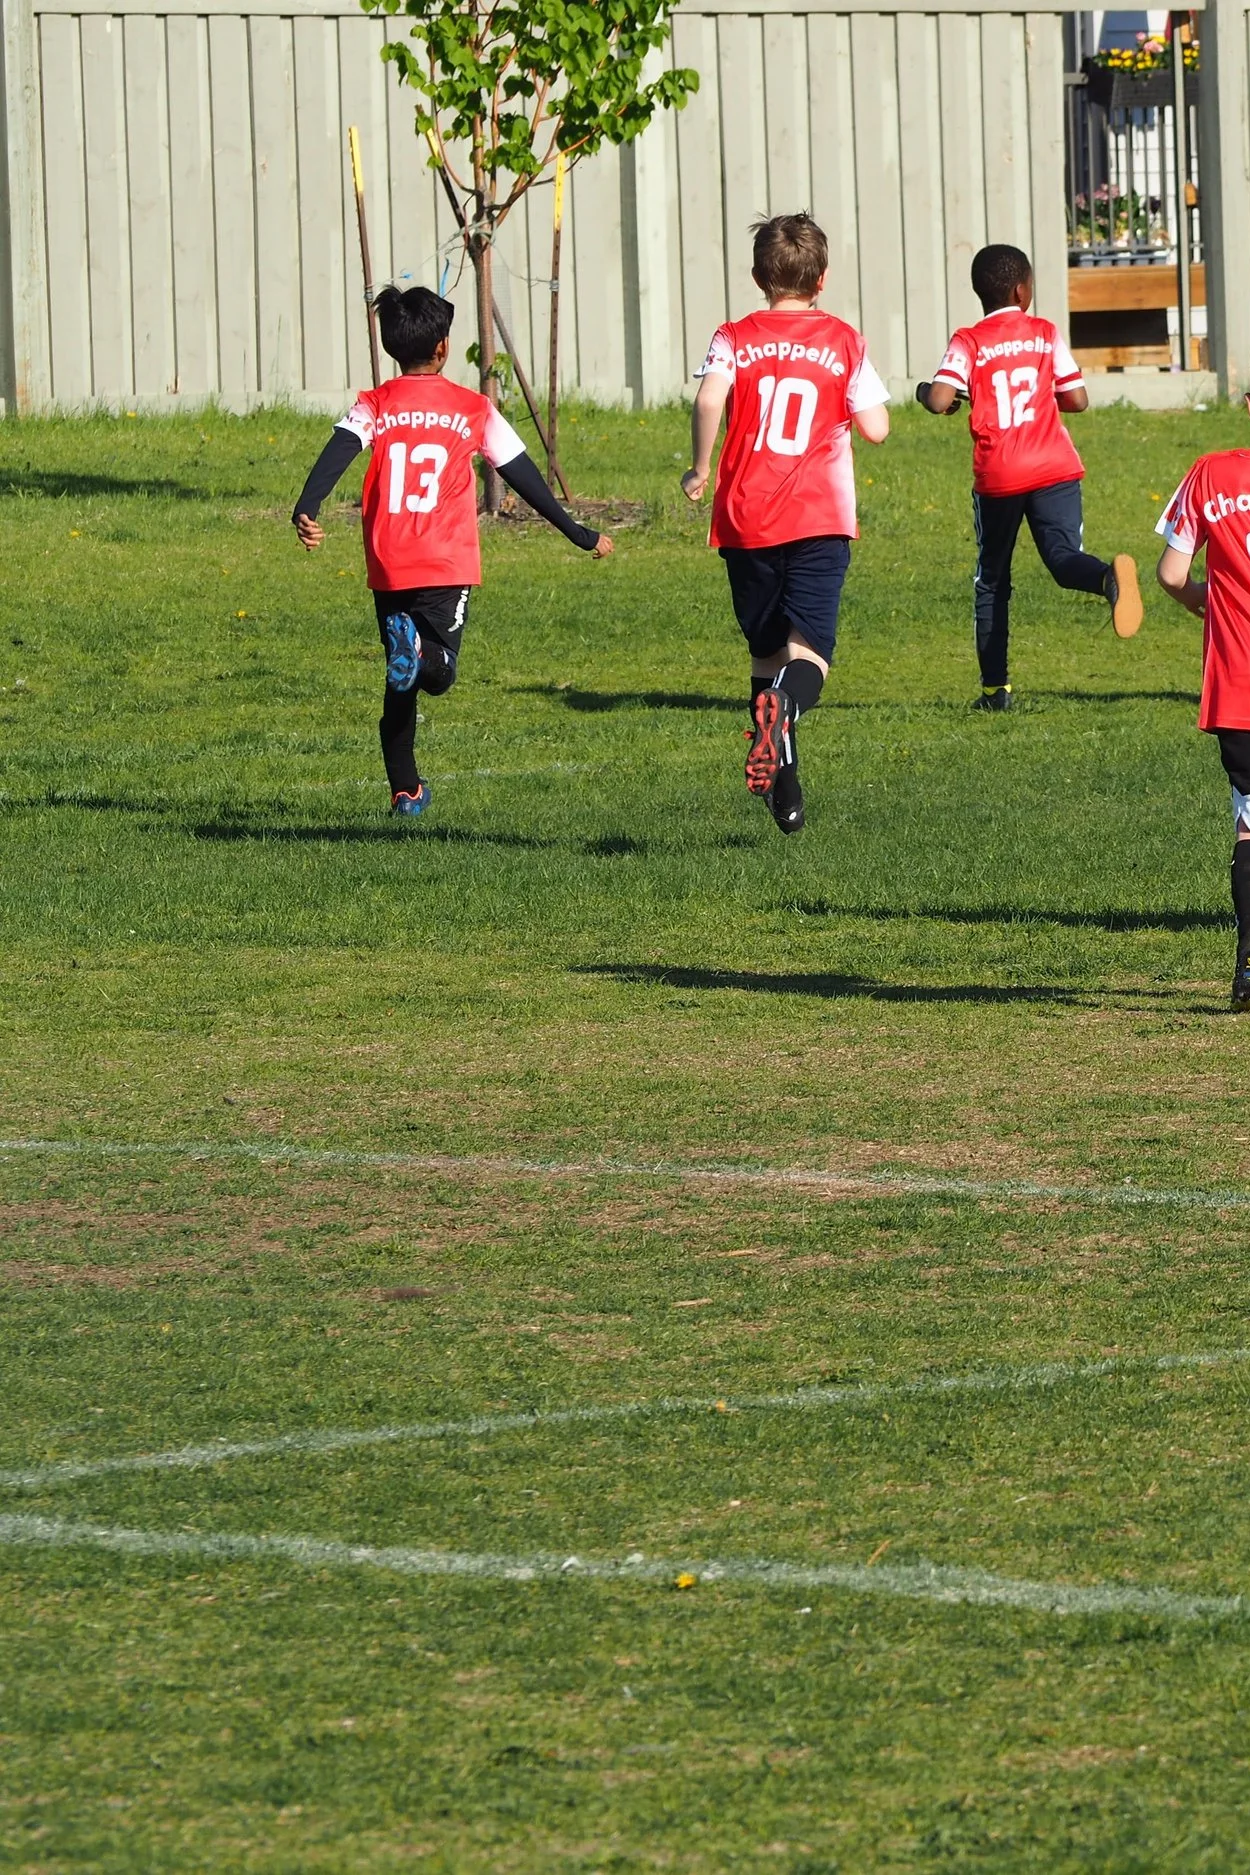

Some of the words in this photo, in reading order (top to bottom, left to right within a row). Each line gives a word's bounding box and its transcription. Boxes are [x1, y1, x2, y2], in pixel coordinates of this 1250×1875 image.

[735, 341, 845, 377] Chappelle
[975, 336, 1053, 367] Chappelle
[753, 375, 819, 456] 10
[991, 366, 1039, 430] 12
[376, 411, 471, 440] Chappelle
[388, 442, 449, 514] 13
